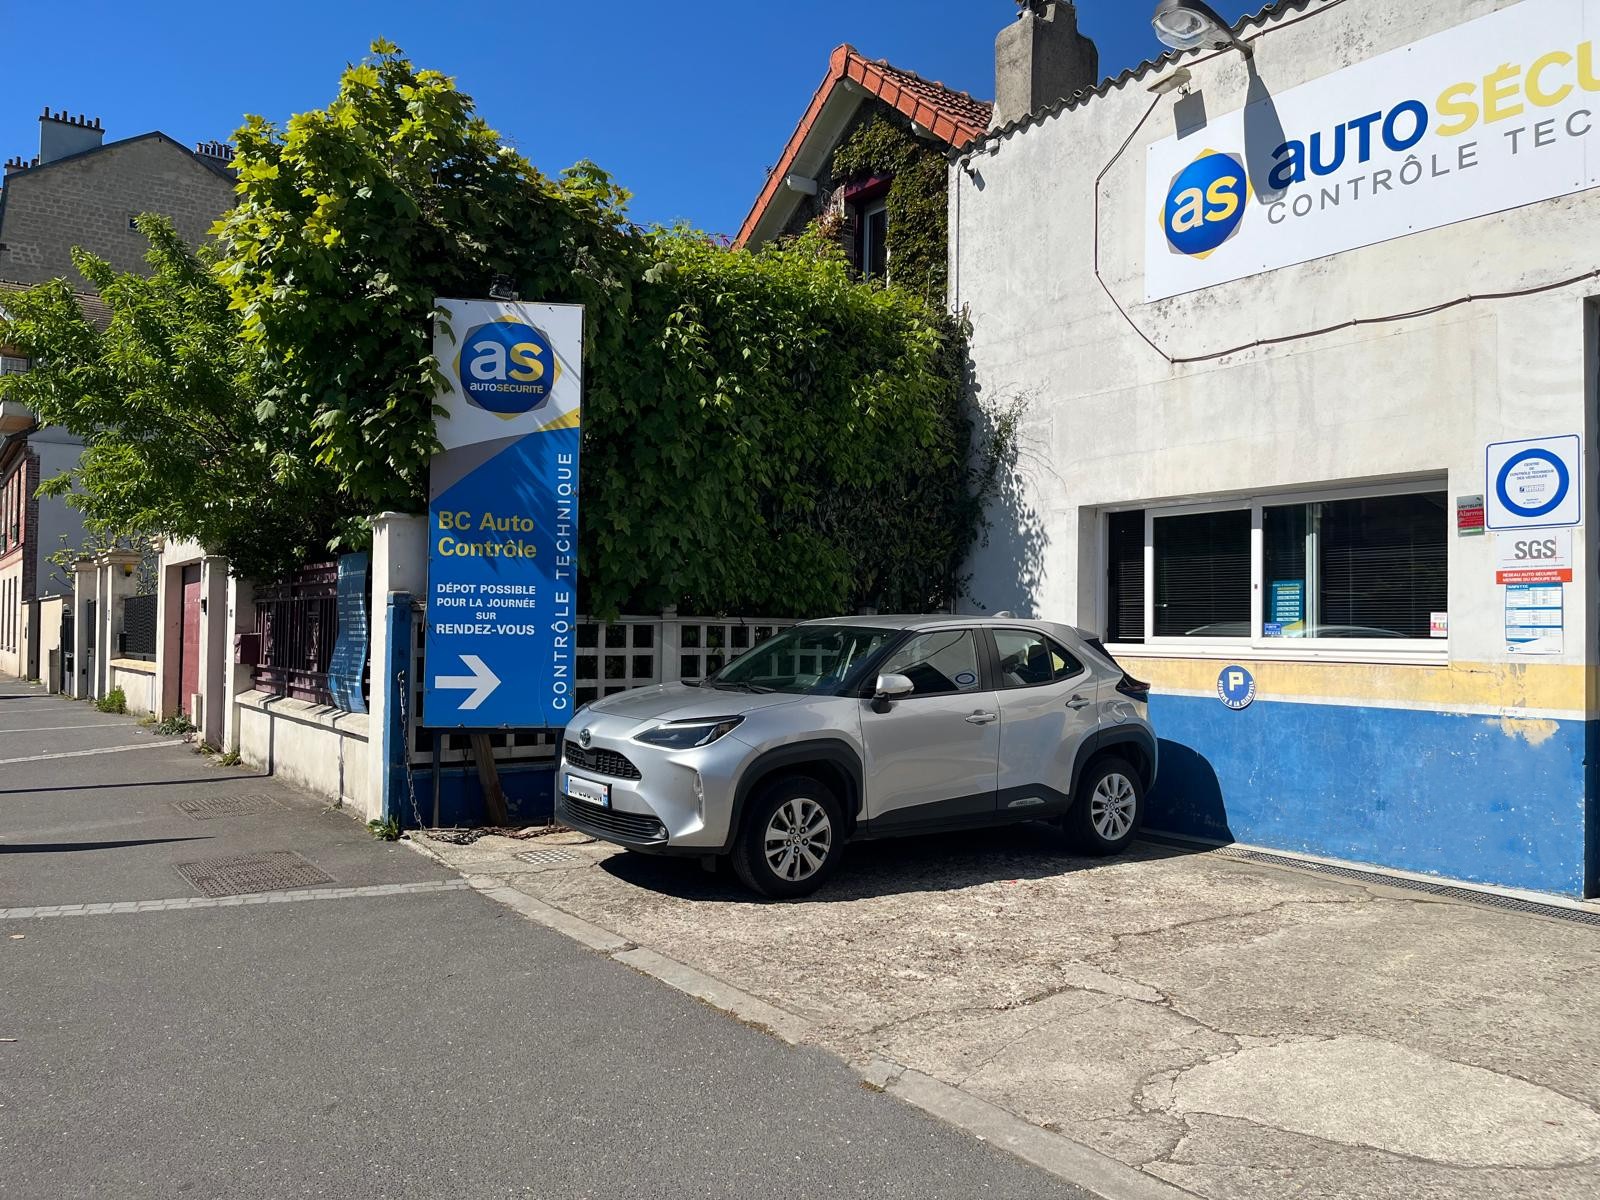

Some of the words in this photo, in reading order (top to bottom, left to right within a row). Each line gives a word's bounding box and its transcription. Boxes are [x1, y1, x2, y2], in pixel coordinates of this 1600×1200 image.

[1268, 153, 1478, 225] CONTRÔLE
[1503, 109, 1592, 155] TEC
[1171, 175, 1238, 233] as
[469, 340, 545, 382] as
[438, 510, 472, 530] BC
[479, 512, 534, 532] Auto
[556, 453, 572, 580] TECHNIQUE
[438, 536, 537, 558] Contrôle
[1514, 539, 1556, 560] SGS
[437, 582, 476, 594] DÉPOT
[480, 584, 536, 595] POSSIBLE
[436, 597, 466, 607] POUR
[469, 598, 483, 608] LA
[487, 597, 536, 608] JOURNÉE
[475, 611, 497, 620] SUR
[436, 623, 535, 636] RENDEZ-VOUS
[551, 591, 570, 710] CONTRÔLE
[1229, 671, 1244, 691] P
